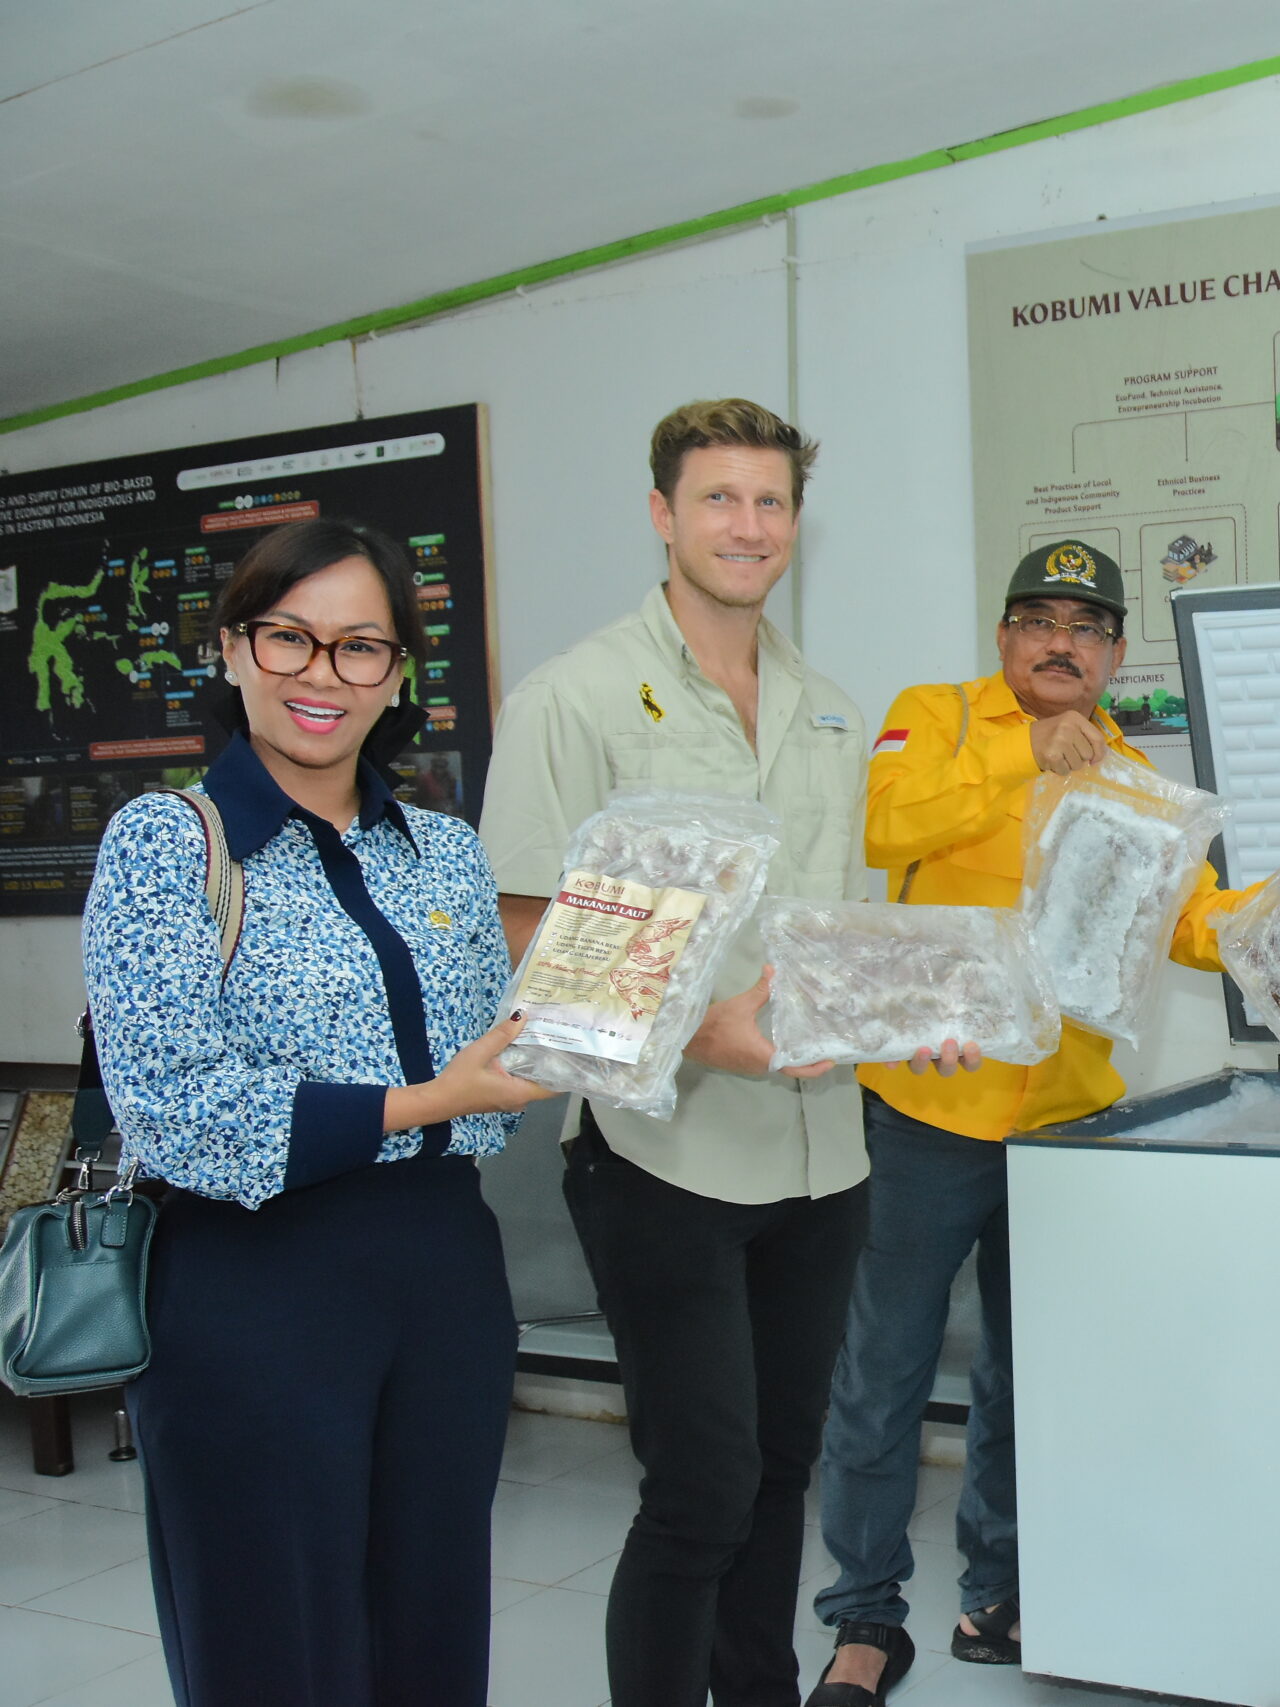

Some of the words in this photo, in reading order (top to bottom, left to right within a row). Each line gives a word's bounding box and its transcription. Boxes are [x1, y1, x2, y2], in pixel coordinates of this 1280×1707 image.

[1012, 291, 1121, 327] KOBUMI
[1127, 278, 1216, 311] VALUE
[1123, 371, 1171, 386] PROGRAM
[1174, 366, 1219, 381] SUPPORT
[1150, 387, 1182, 398] Technical
[1118, 400, 1181, 413] Entrepreneurship
[1182, 395, 1222, 406] Incubation
[1050, 482, 1082, 491] Practices
[1083, 480, 1091, 488] of
[1092, 478, 1112, 487] Local
[1189, 474, 1220, 484] Business
[1080, 489, 1120, 499] Community
[1172, 488, 1206, 497] Practices
[1044, 506, 1072, 514] Product
[1073, 503, 1102, 513] Support
[1109, 673, 1166, 685] ENEFICIARIES
[575, 878, 626, 895] KOBUMI
[566, 895, 619, 913] MAKANAN
[619, 906, 649, 919] LAUT
